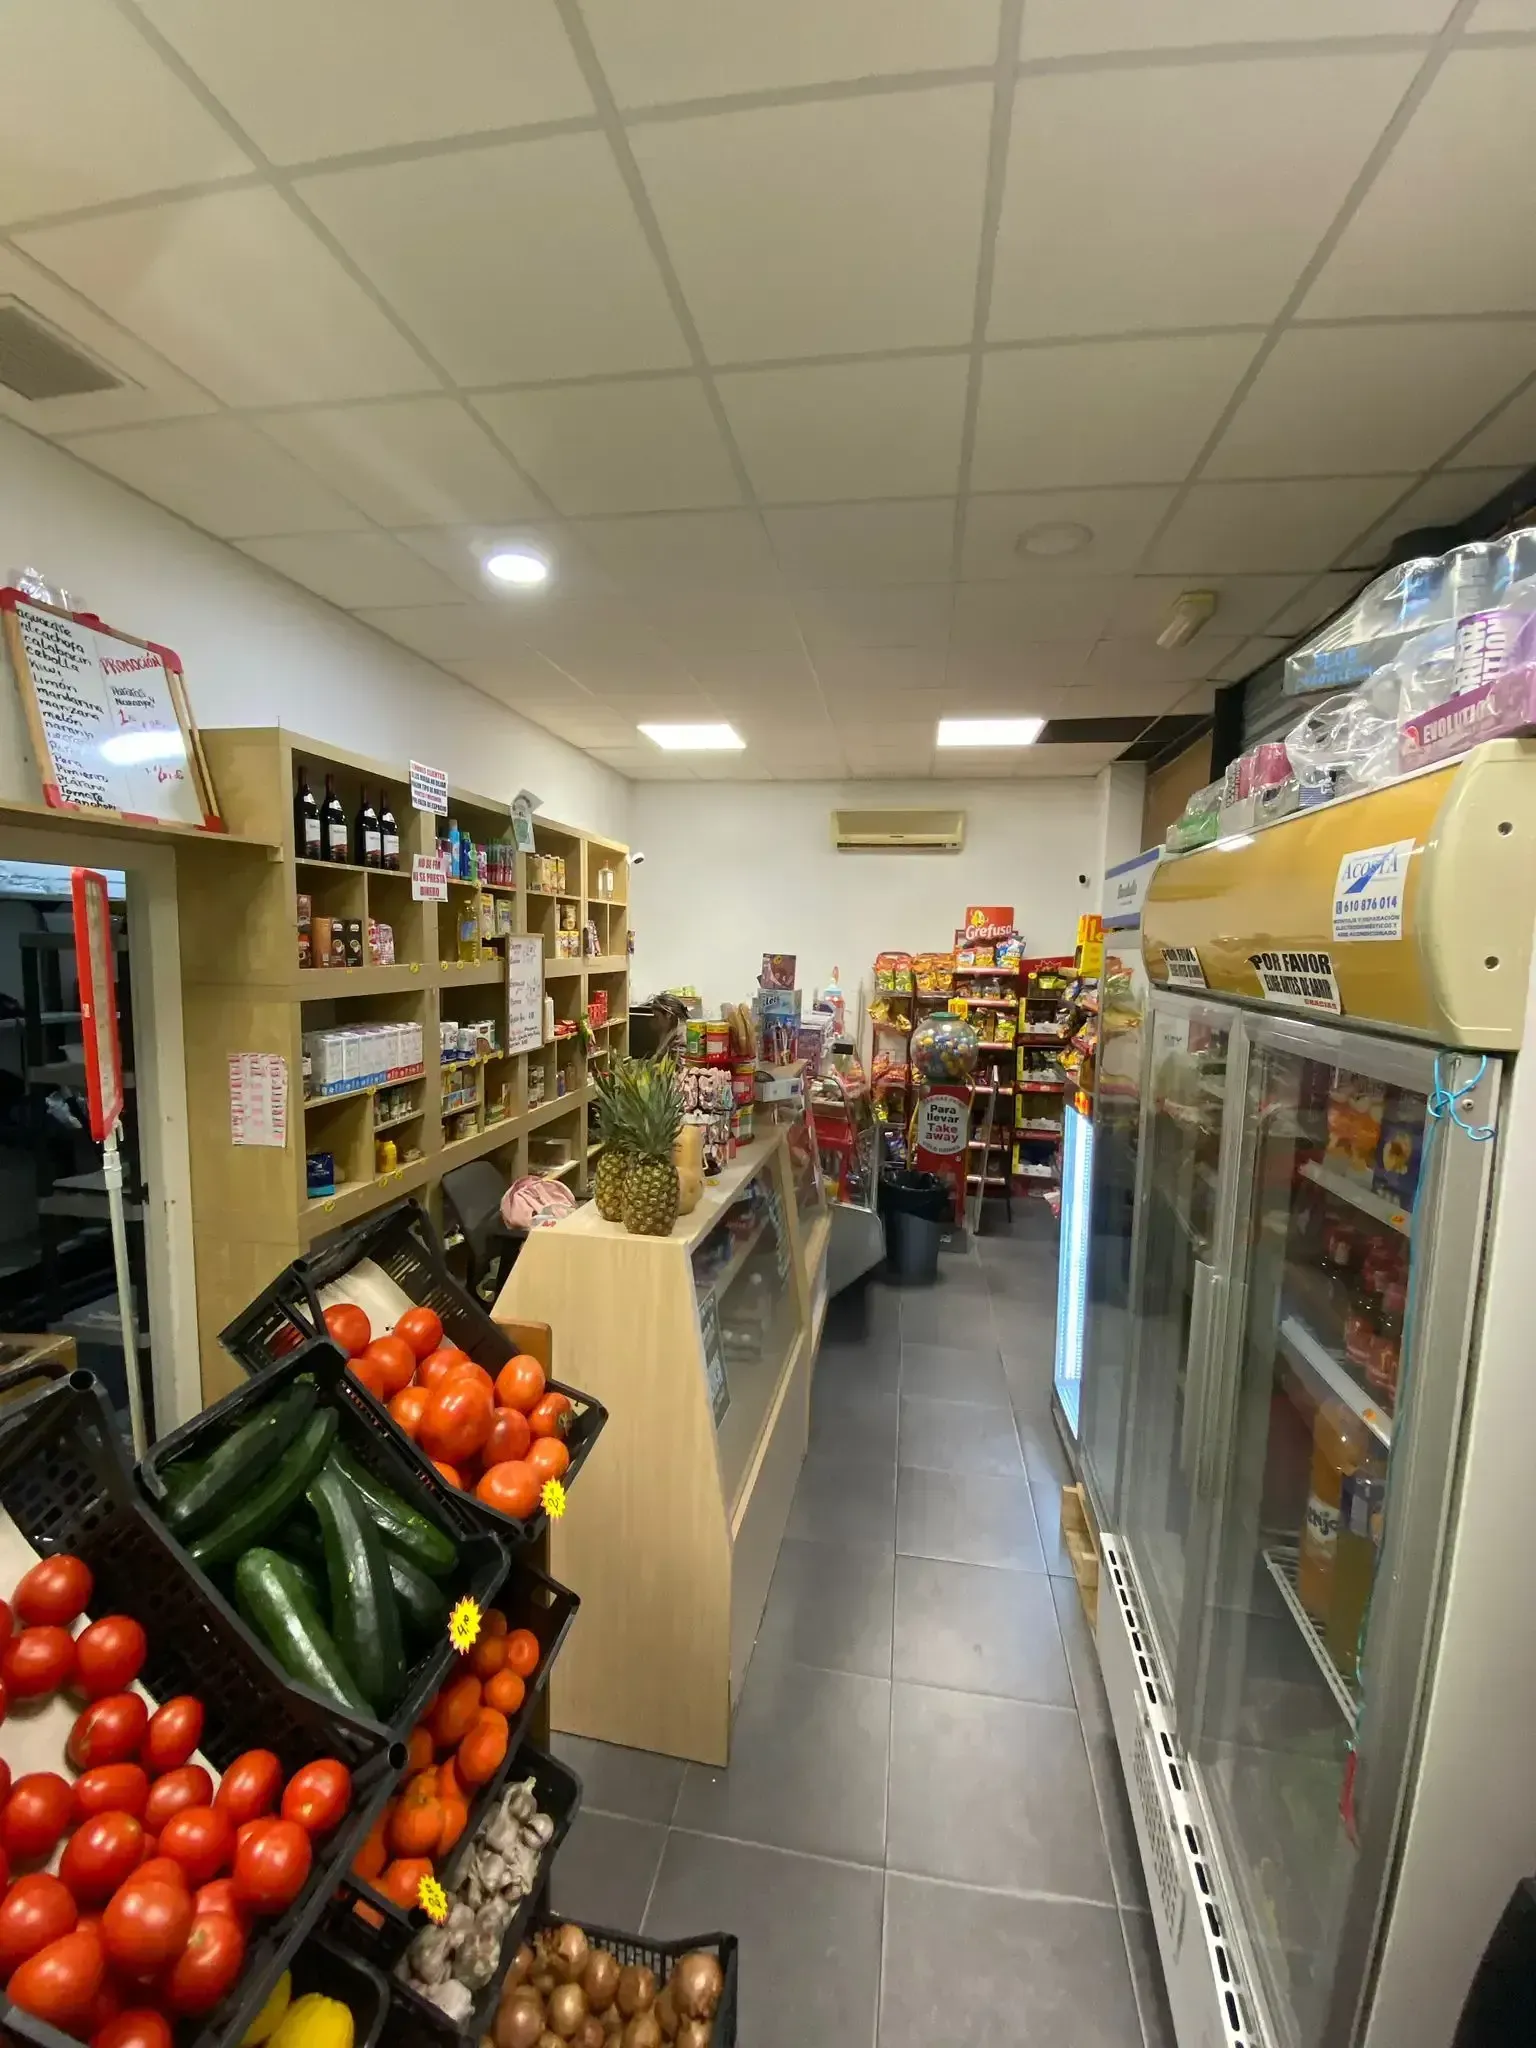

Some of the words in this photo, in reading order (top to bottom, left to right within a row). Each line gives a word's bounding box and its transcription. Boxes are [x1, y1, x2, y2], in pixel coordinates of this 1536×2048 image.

[100, 652, 162, 676] PROMOCIÓN
[1343, 900, 1360, 912] 610
[1360, 897, 1378, 911] 876
[1379, 896, 1398, 910] 014
[965, 924, 1012, 940] Grefusa
[1248, 953, 1282, 971] POR
[1281, 953, 1332, 975] FAVOR
[1299, 977, 1312, 998] DE
[930, 1104, 956, 1114] Para
[927, 1112, 960, 1123] llevar
[927, 1122, 958, 1133] Take
[925, 1132, 959, 1143] away
